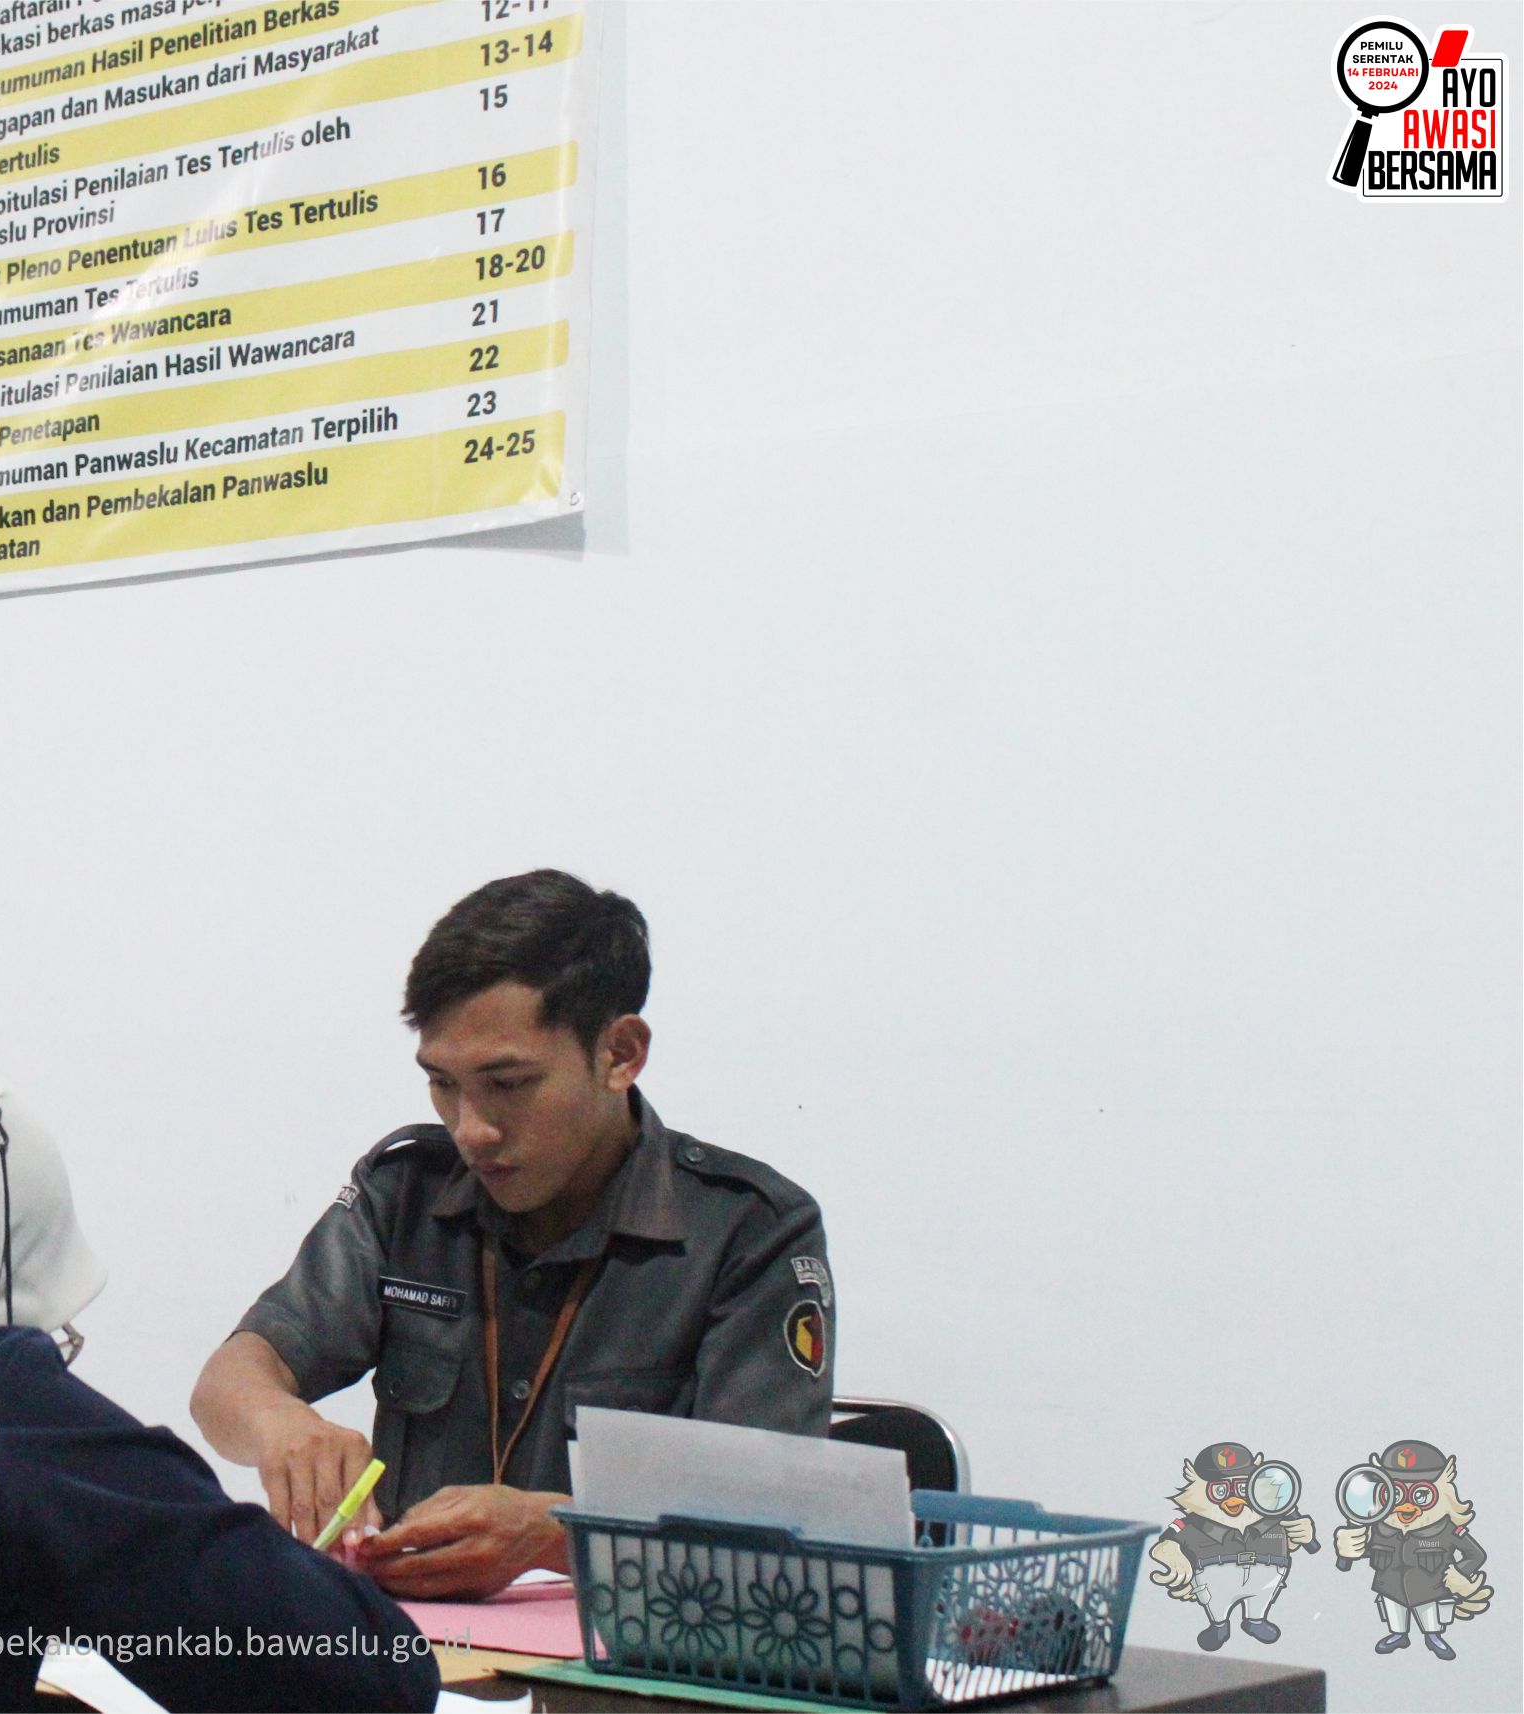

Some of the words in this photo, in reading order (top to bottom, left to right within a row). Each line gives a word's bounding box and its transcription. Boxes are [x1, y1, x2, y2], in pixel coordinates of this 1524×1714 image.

[47, 14, 115, 43] berkas
[121, 0, 176, 26] masa
[91, 39, 144, 73] Hasil
[150, 18, 257, 60] Penelitian
[264, 0, 340, 32] Berkas
[480, 30, 553, 66] 13-14
[61, 97, 98, 121] dan
[104, 74, 200, 111] Masukan
[206, 57, 246, 88] dari
[253, 25, 380, 77] Masyarakat
[478, 84, 508, 112] 15
[75, 162, 168, 199] Penilaian
[175, 153, 211, 177] Tes
[218, 130, 295, 168] Tertulis
[301, 116, 351, 147] oleh
[478, 162, 507, 190] 16
[7, 256, 61, 285] Pleno
[68, 235, 177, 271] Penentuan
[183, 219, 237, 249] Lulus
[245, 210, 283, 234] Tes
[290, 189, 378, 226] Tertulis
[33, 200, 115, 239] Provinsi
[476, 208, 505, 235] 17
[475, 245, 546, 280] 18-20
[85, 286, 119, 310] Tes
[472, 299, 498, 327] 21
[111, 306, 232, 345] Wawancara
[66, 361, 158, 394] Penilaian
[165, 346, 221, 378] Hasil
[228, 329, 355, 368] Wawancara
[469, 344, 499, 372] 22
[466, 390, 496, 418] 23
[75, 441, 179, 477] Panwaslu
[184, 425, 304, 462] Kecamatan
[311, 406, 398, 442] Terpilih
[464, 429, 536, 464] 24-25
[42, 499, 80, 524] dan
[87, 480, 216, 519] Pembekalan
[222, 461, 329, 499] Panwaslu
[383, 1285, 429, 1304] MOHAMAD
